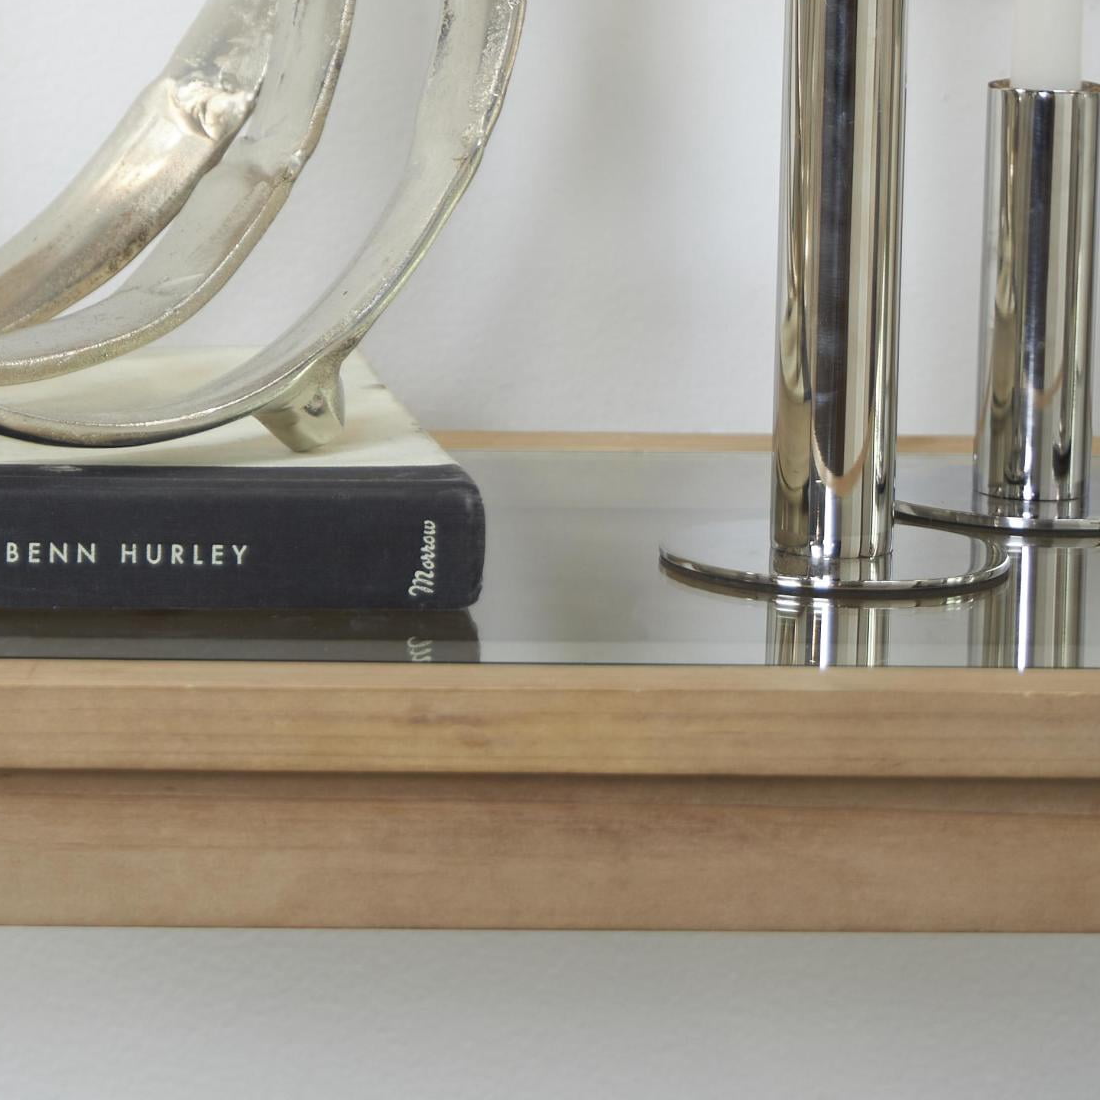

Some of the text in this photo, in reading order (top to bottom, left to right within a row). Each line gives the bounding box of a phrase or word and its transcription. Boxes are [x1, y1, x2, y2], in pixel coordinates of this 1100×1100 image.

[5, 540, 97, 565] BENN
[119, 542, 249, 566] HURLEY
[407, 518, 437, 597] Morrow
